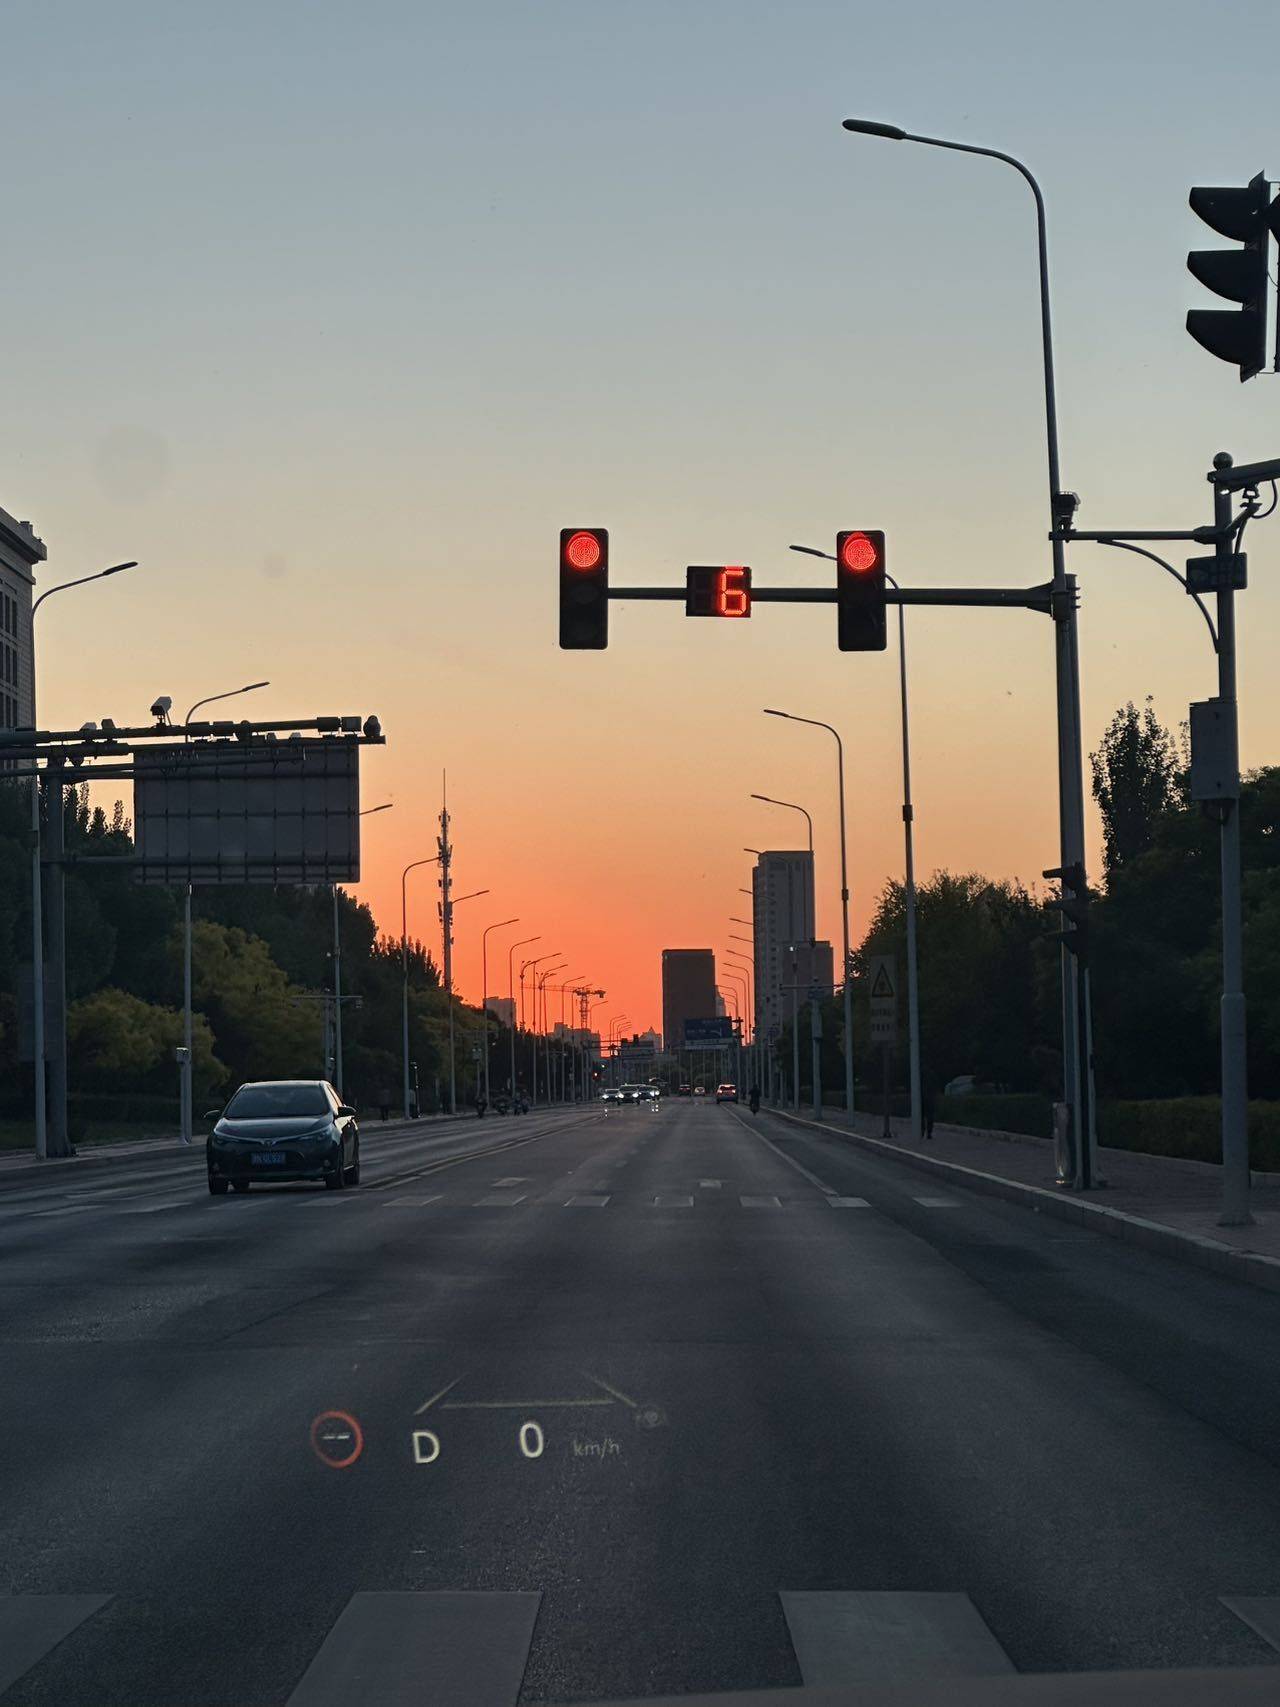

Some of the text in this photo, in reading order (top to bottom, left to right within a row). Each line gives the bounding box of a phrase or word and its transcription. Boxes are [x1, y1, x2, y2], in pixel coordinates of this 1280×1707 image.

[720, 568, 747, 616] 6
[412, 1422, 622, 1463] D 0 km/h
